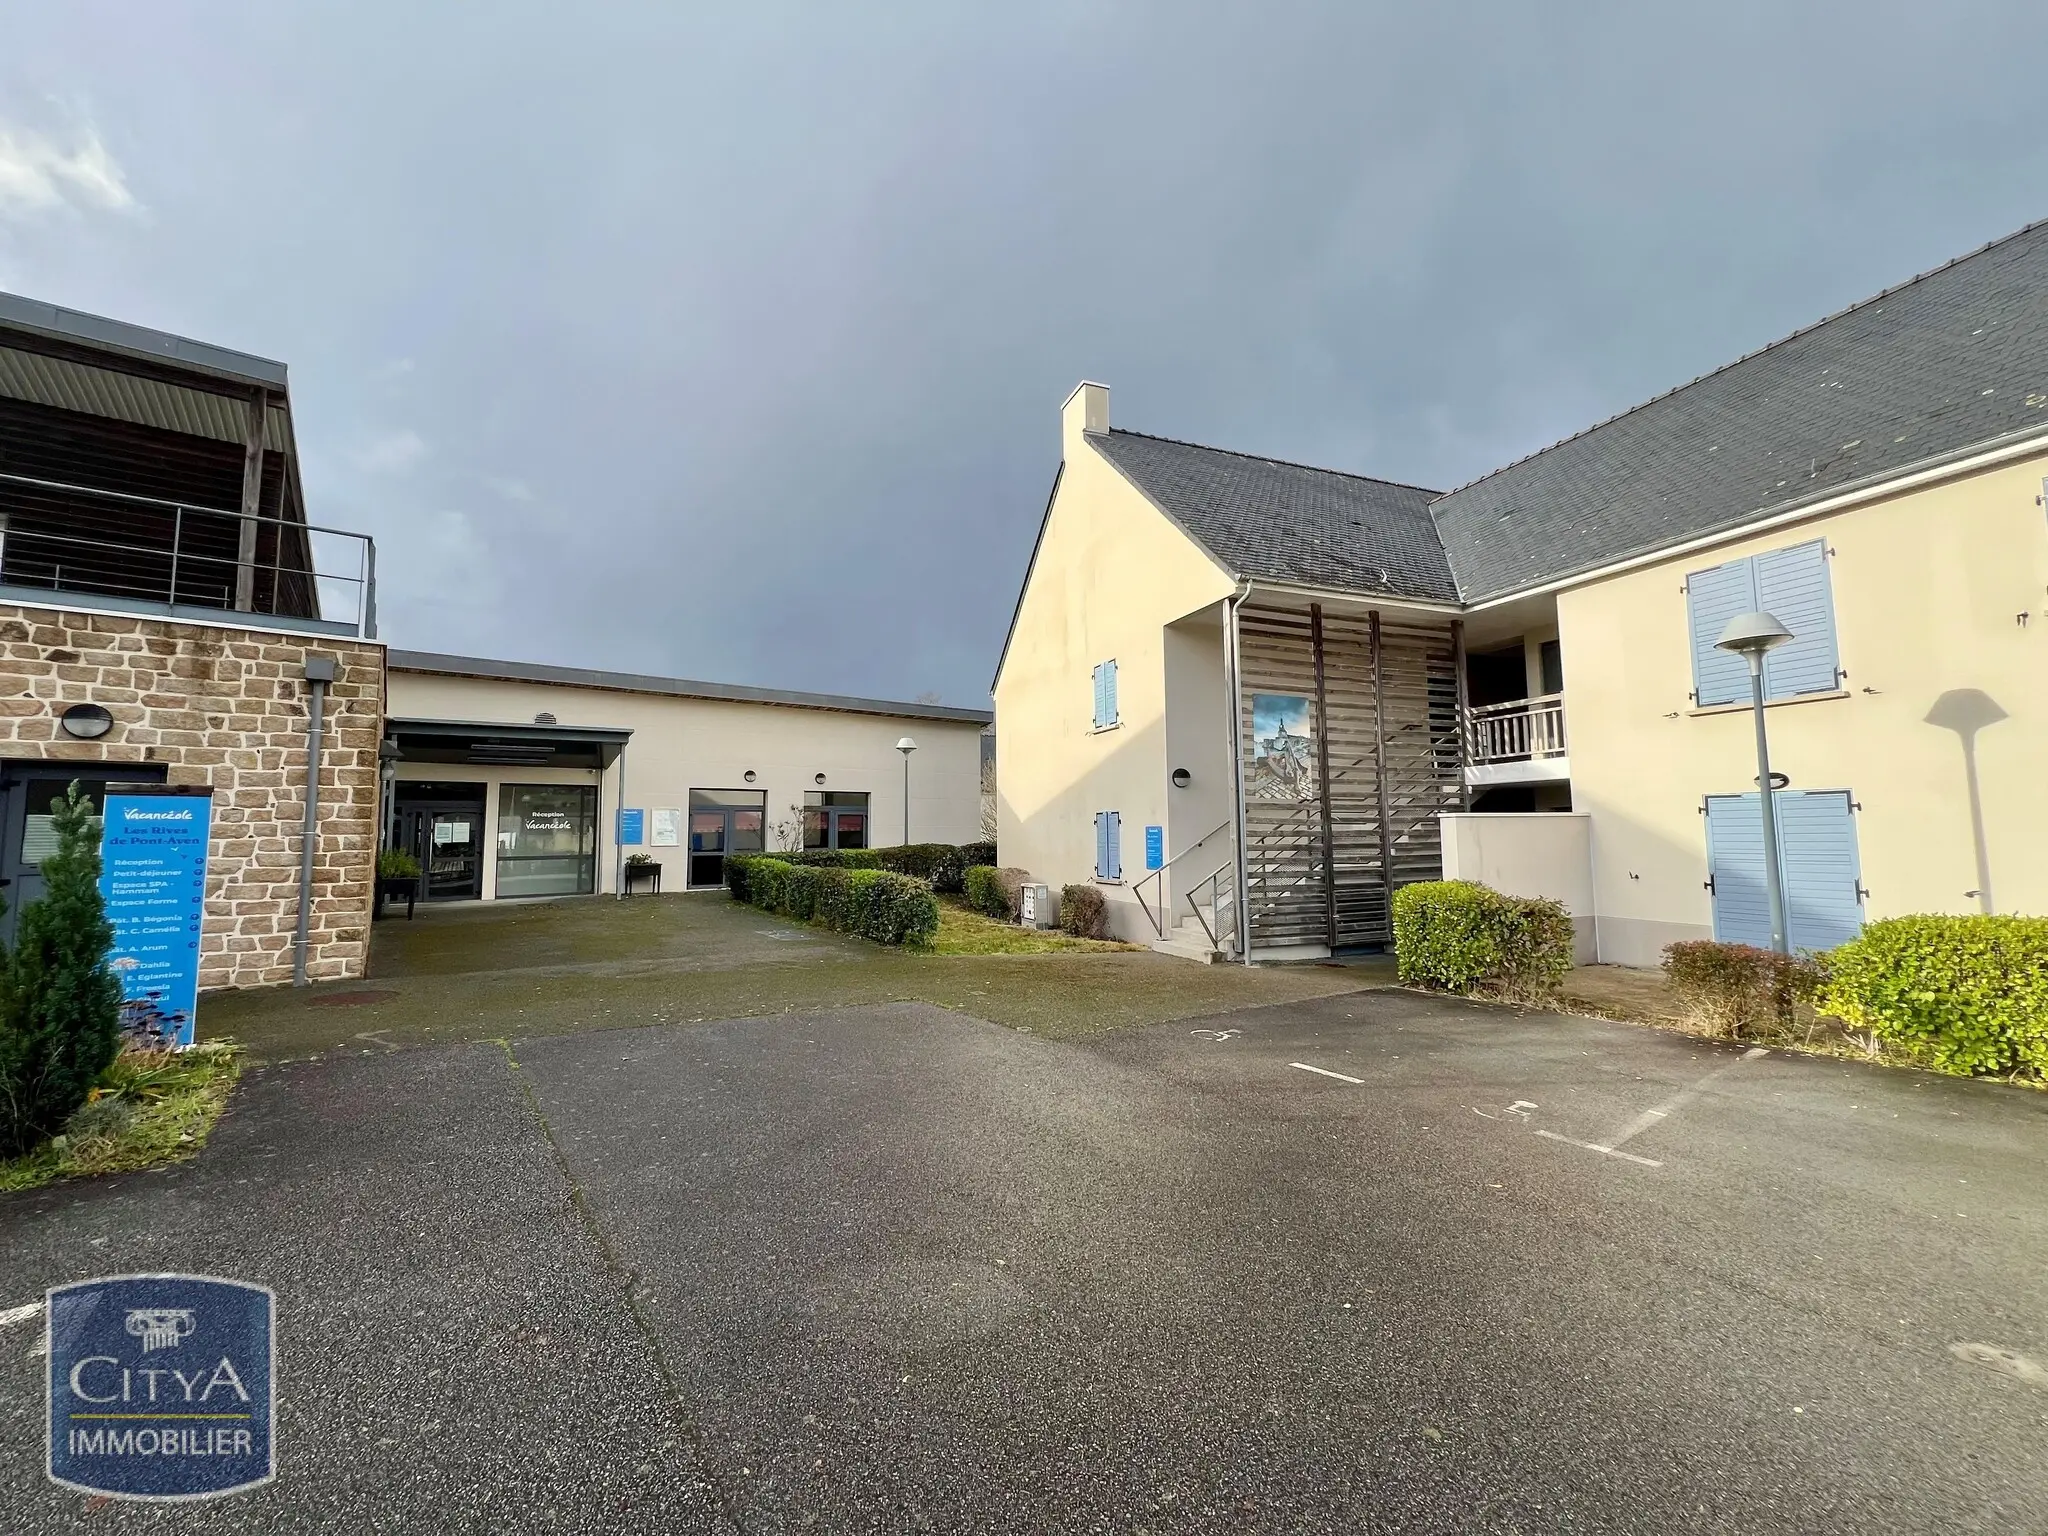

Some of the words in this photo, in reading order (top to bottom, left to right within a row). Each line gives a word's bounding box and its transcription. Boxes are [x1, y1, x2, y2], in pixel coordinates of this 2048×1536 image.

[124, 808, 193, 820] Vacancéole
[525, 819, 572, 830] Vacancéole
[124, 827, 148, 835] Les
[151, 827, 189, 835] Rives
[109, 837, 128, 845] de
[130, 837, 200, 845] Pont-Aven
[112, 881, 147, 889] Espace
[144, 914, 183, 923] Bégonia
[142, 926, 181, 934] Camélia
[138, 972, 183, 981] Eglantine
